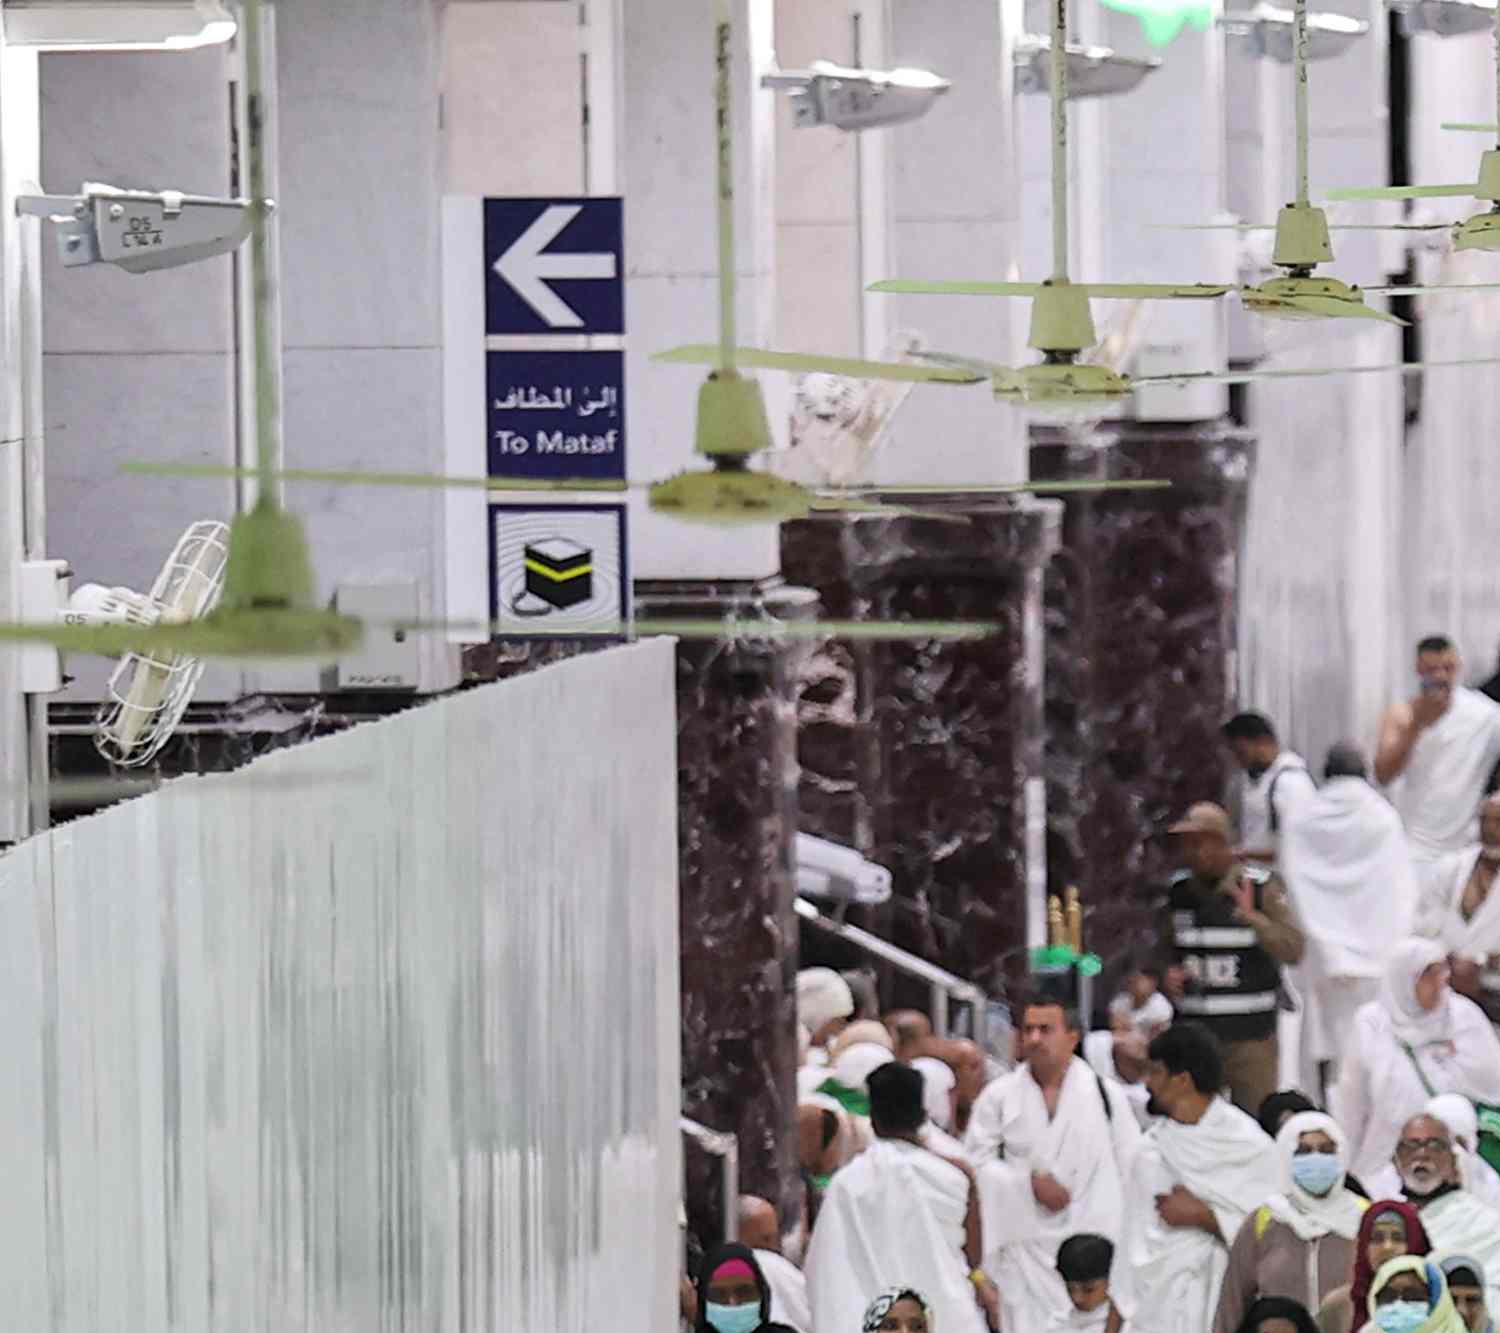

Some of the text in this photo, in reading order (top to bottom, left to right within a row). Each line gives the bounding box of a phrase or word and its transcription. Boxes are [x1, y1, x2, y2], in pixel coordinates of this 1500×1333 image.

[494, 386, 572, 410] المطاف
[495, 430, 619, 455] To Mataf
